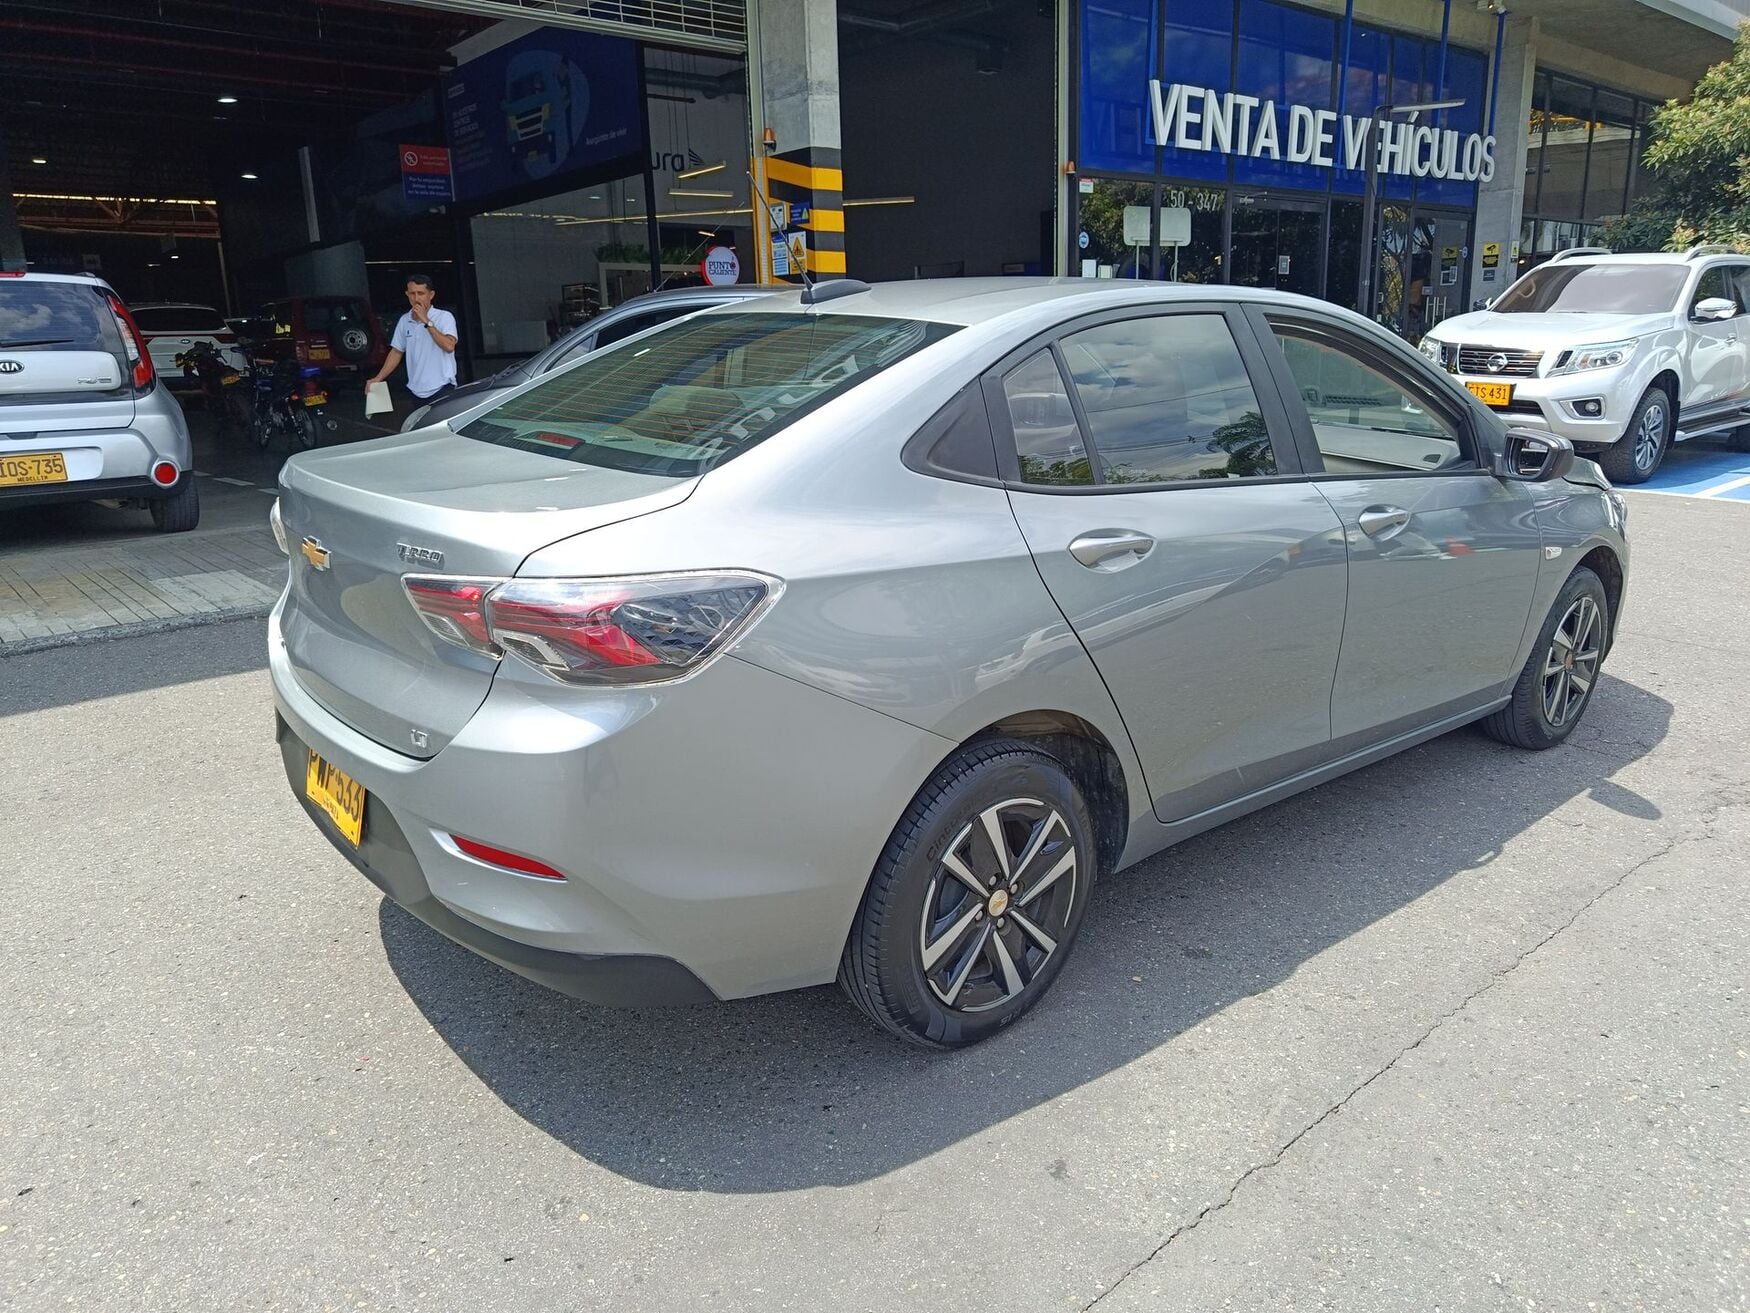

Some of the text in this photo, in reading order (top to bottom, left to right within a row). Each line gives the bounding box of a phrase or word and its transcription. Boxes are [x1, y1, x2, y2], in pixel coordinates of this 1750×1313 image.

[1149, 79, 1280, 160] VENTA
[1287, 104, 1337, 167] DE
[1170, 190, 1185, 208] 50
[1196, 192, 1218, 211] 347
[708, 261, 736, 270] PUNTO
